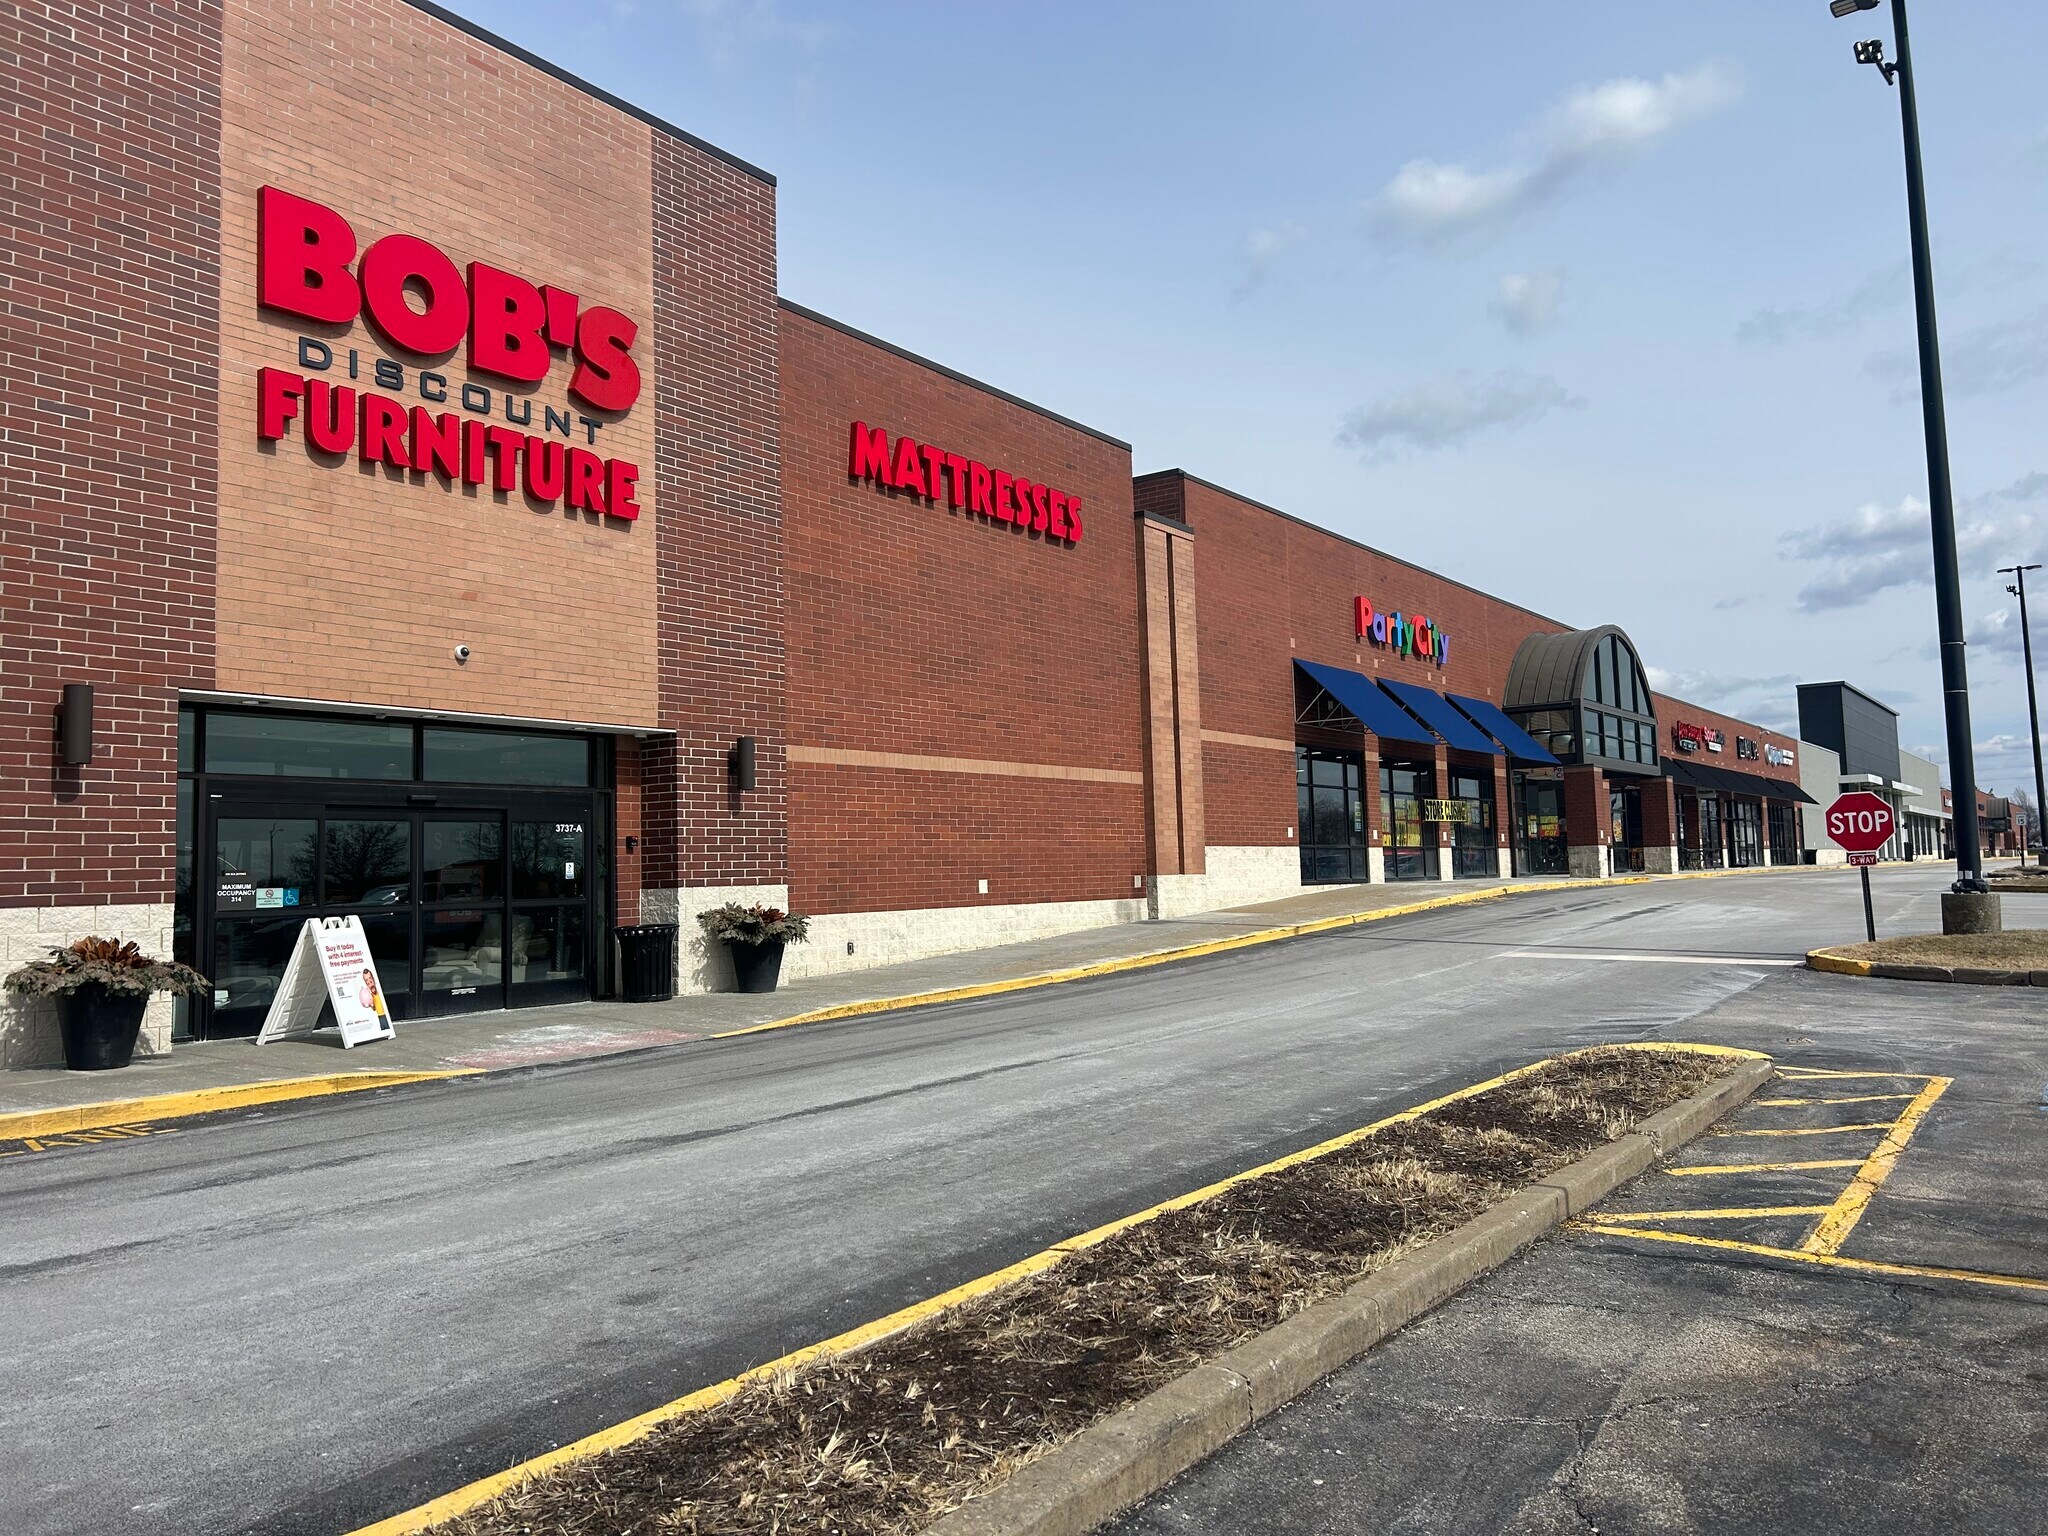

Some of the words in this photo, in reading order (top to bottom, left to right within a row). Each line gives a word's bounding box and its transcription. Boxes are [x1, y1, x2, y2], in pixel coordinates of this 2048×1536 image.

[257, 185, 641, 411] BOB'S
[298, 336, 603, 444] DISCOUNT
[257, 366, 640, 521] FURNITURE
[851, 421, 1083, 542] MATTRESSES
[1425, 800, 1444, 820] STORE
[1830, 810, 1889, 834] STOP
[555, 824, 583, 832] 3737-A
[1851, 856, 1875, 865] 3-WAY
[340, 958, 364, 967] payments
